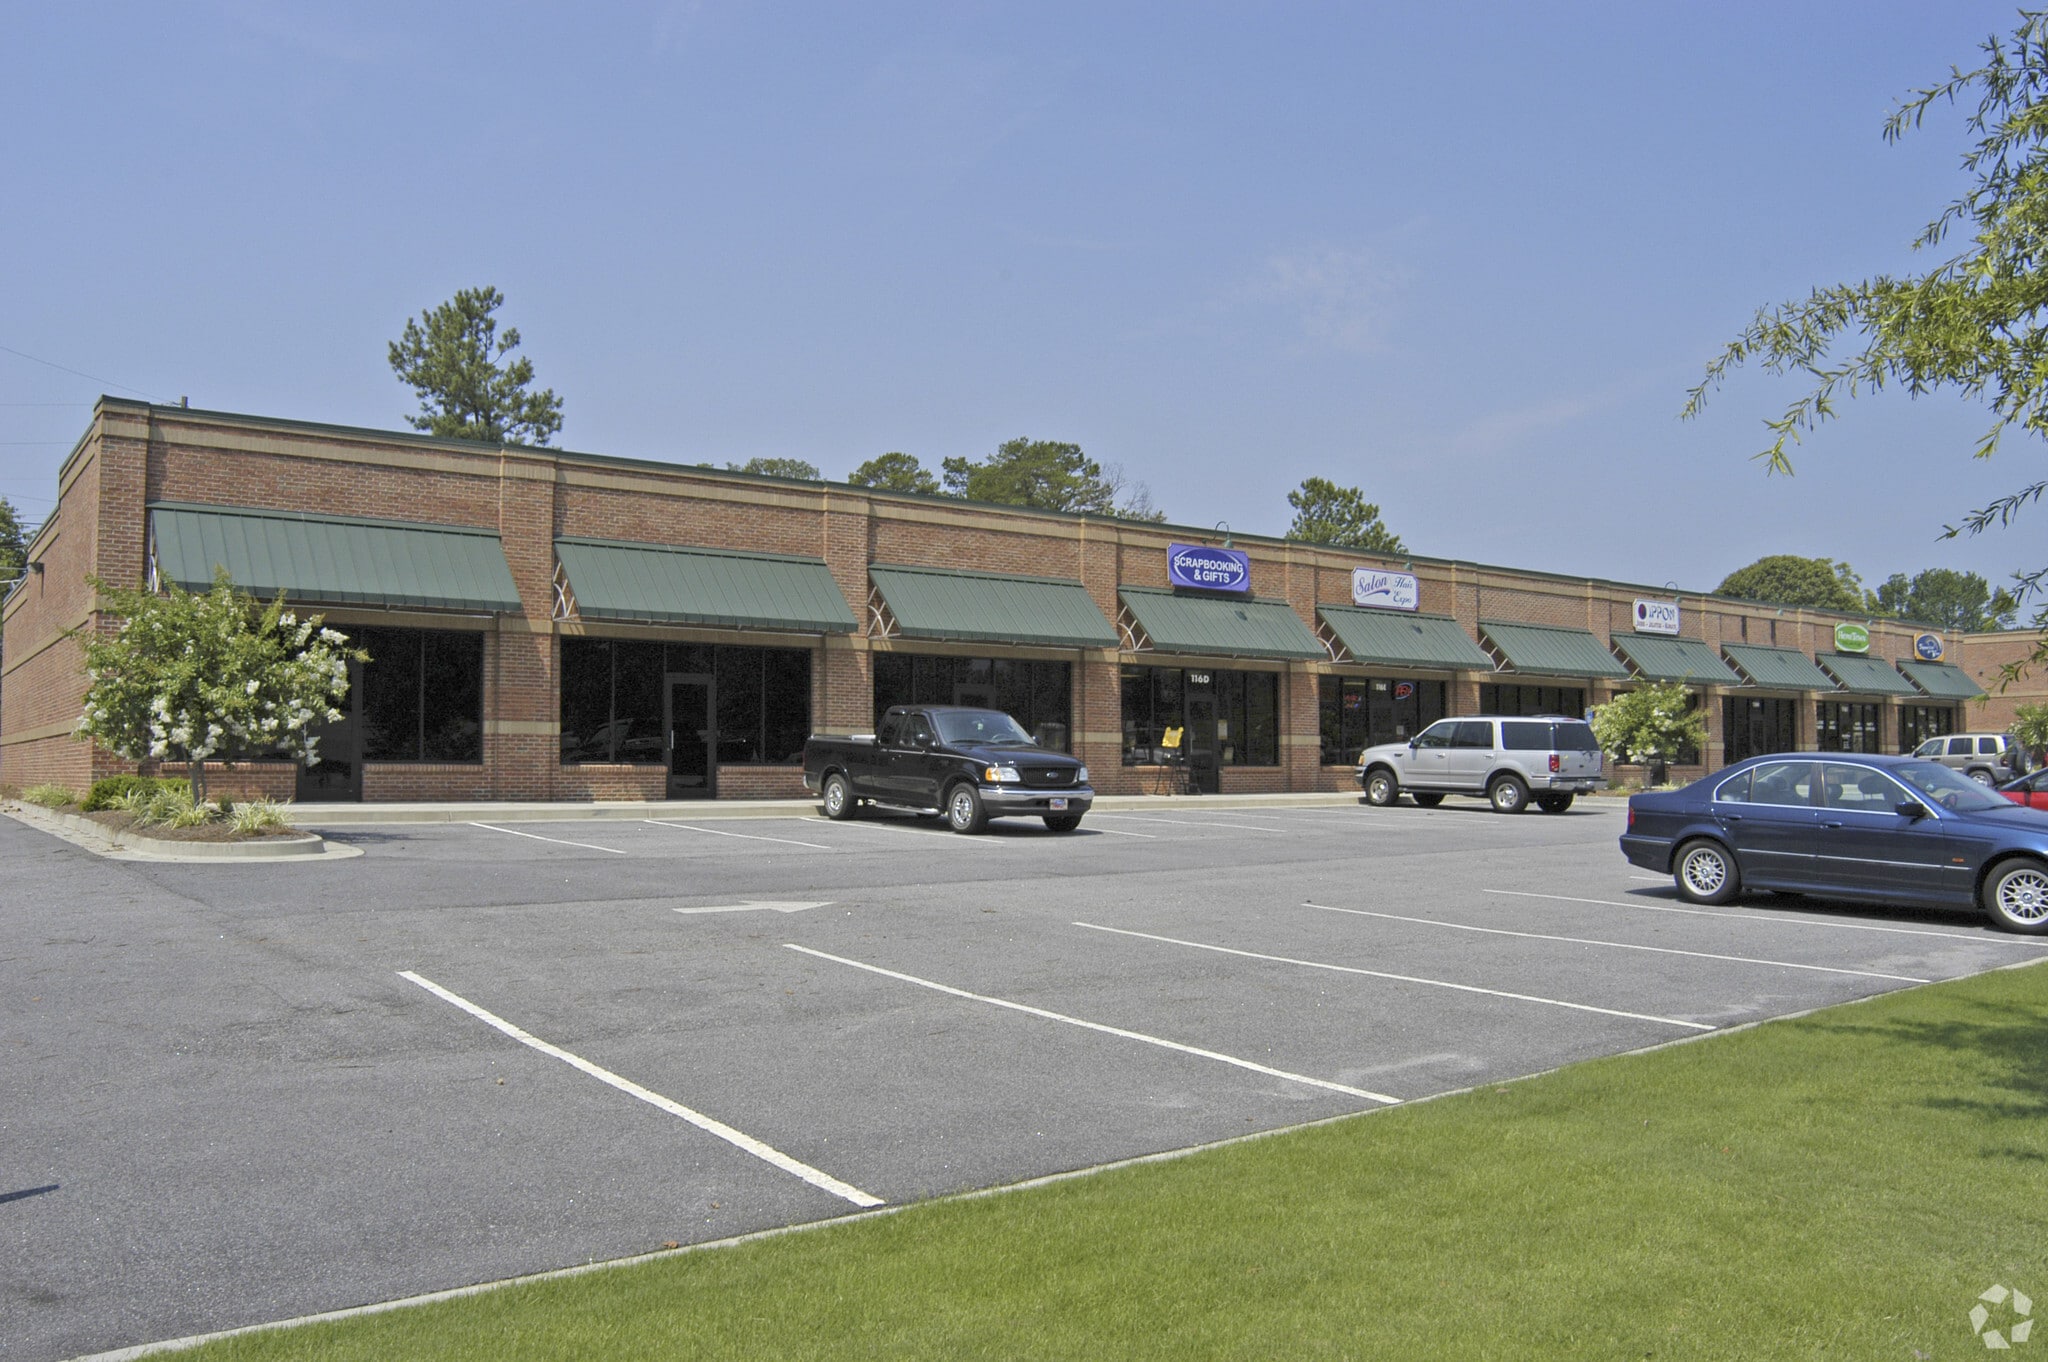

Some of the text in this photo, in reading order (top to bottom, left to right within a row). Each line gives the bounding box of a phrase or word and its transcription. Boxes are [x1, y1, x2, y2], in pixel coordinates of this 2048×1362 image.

[1174, 556, 1243, 573] SCRAPBOOKING
[1194, 569, 1230, 583] & GIFTS
[1356, 574, 1387, 595] Salon
[1191, 674, 1210, 684] 116D
